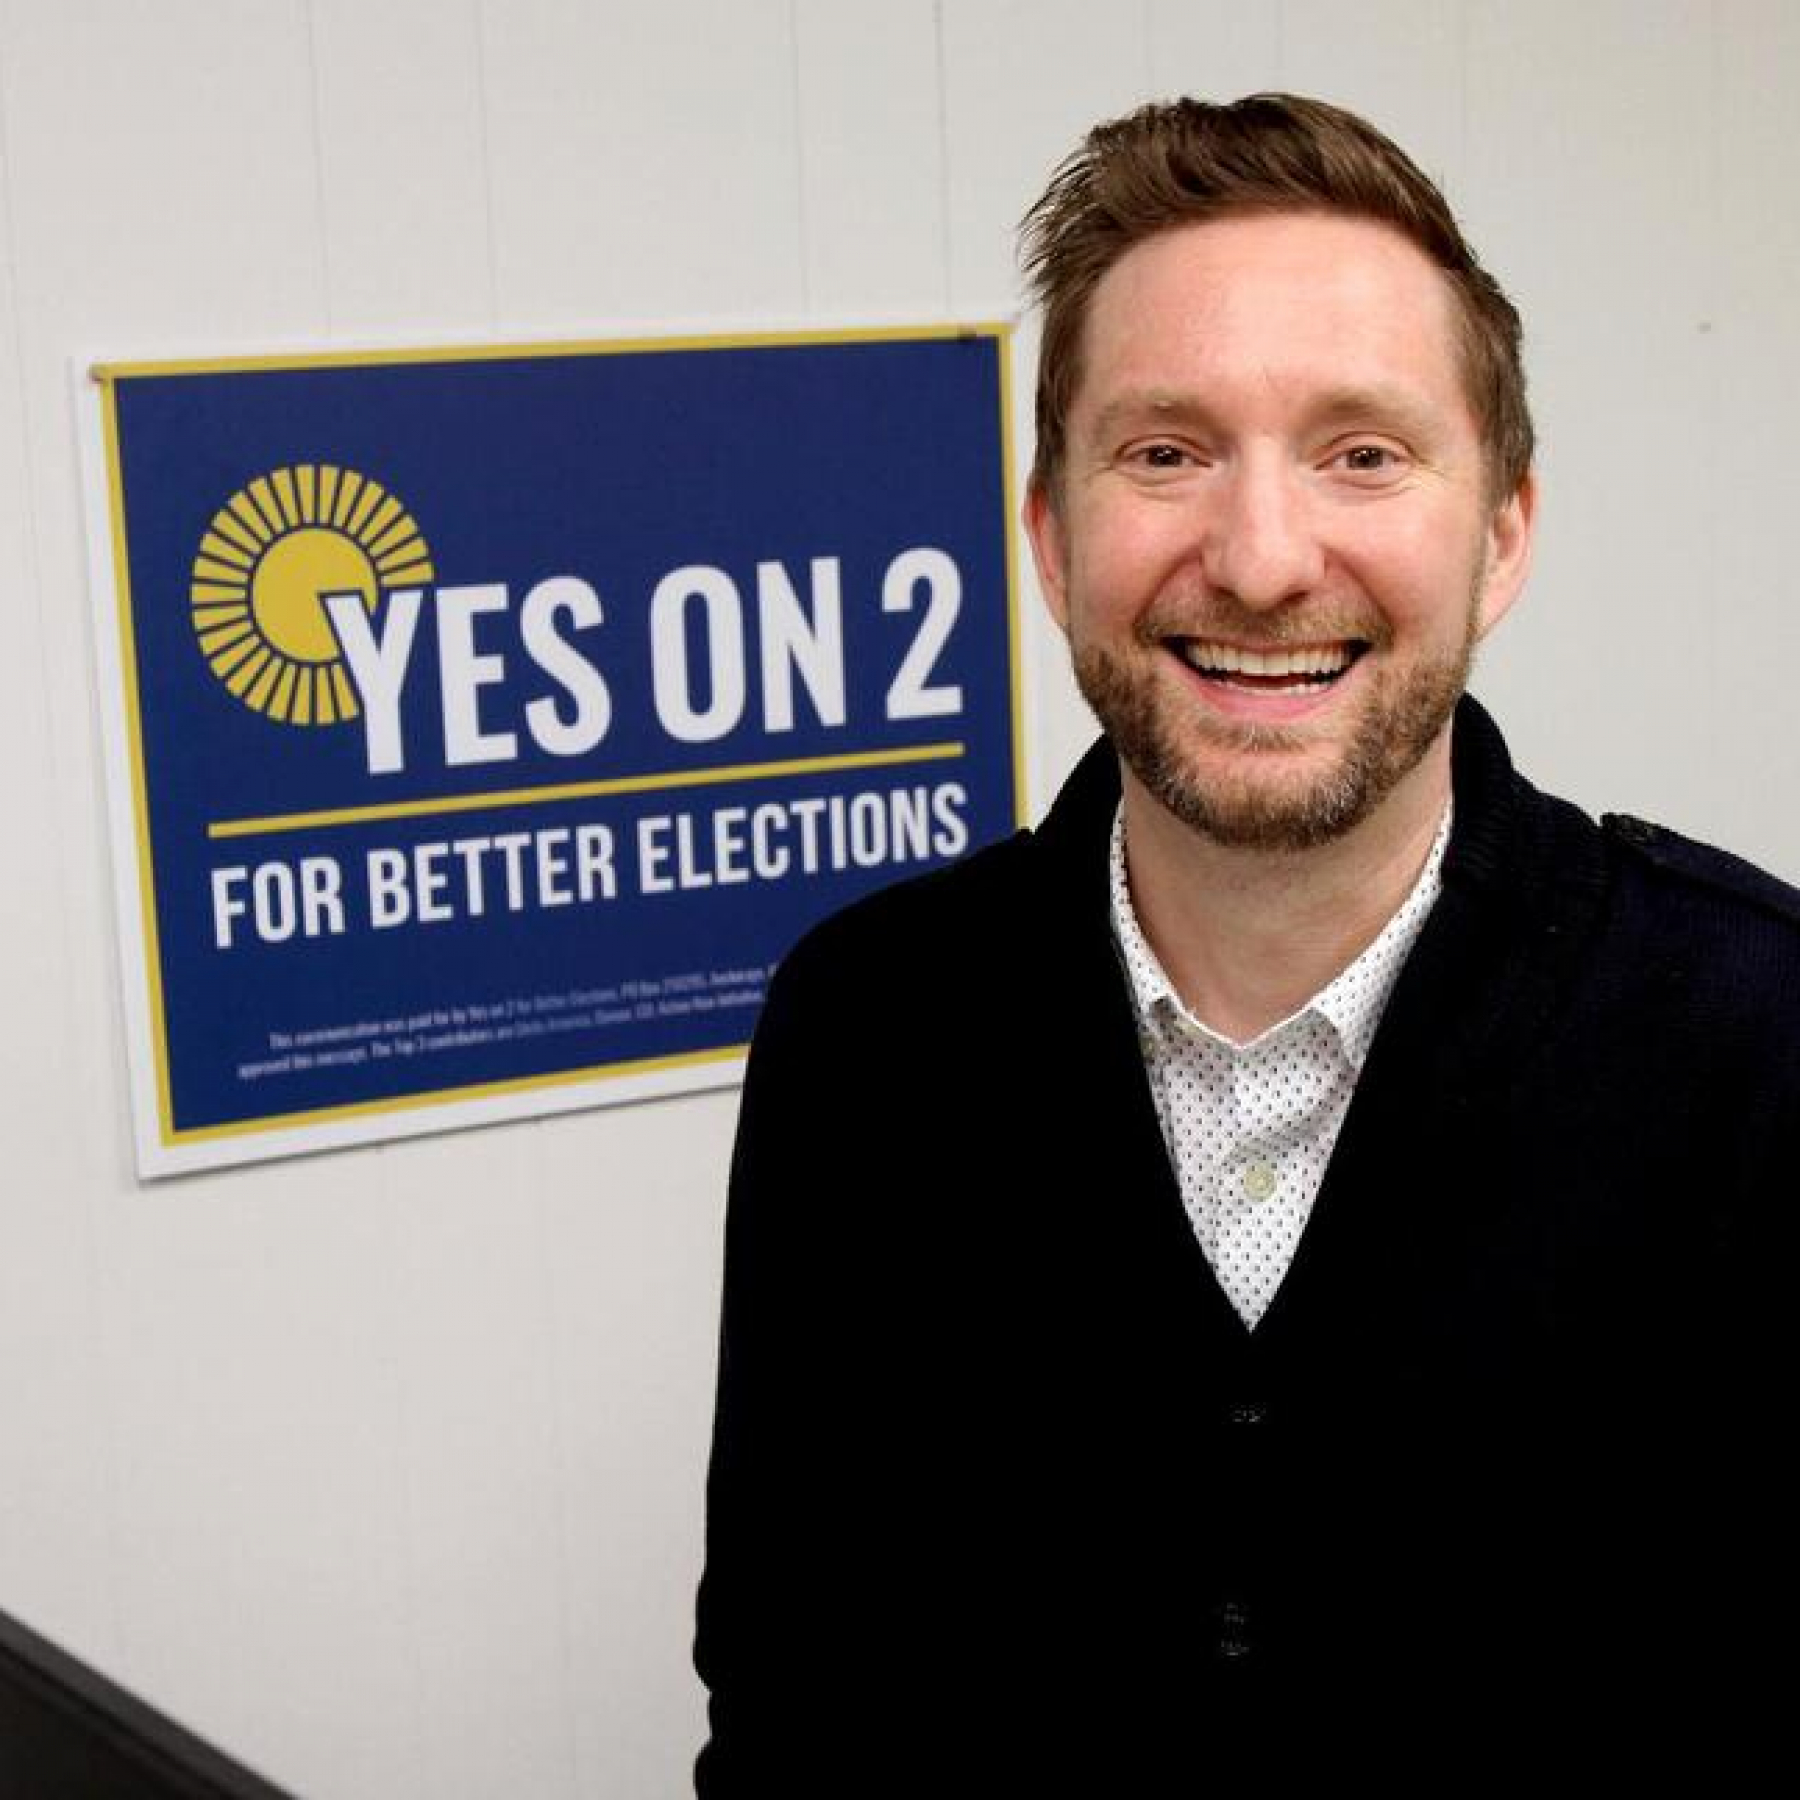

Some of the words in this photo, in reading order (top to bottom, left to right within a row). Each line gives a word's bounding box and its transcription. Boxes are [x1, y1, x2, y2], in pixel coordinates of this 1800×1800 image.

[325, 577, 611, 774] YES
[650, 557, 846, 744] ON
[882, 547, 962, 719] 2
[211, 856, 344, 948] FOR
[368, 825, 617, 928] BETTER
[638, 783, 969, 894] ELECTIONS
